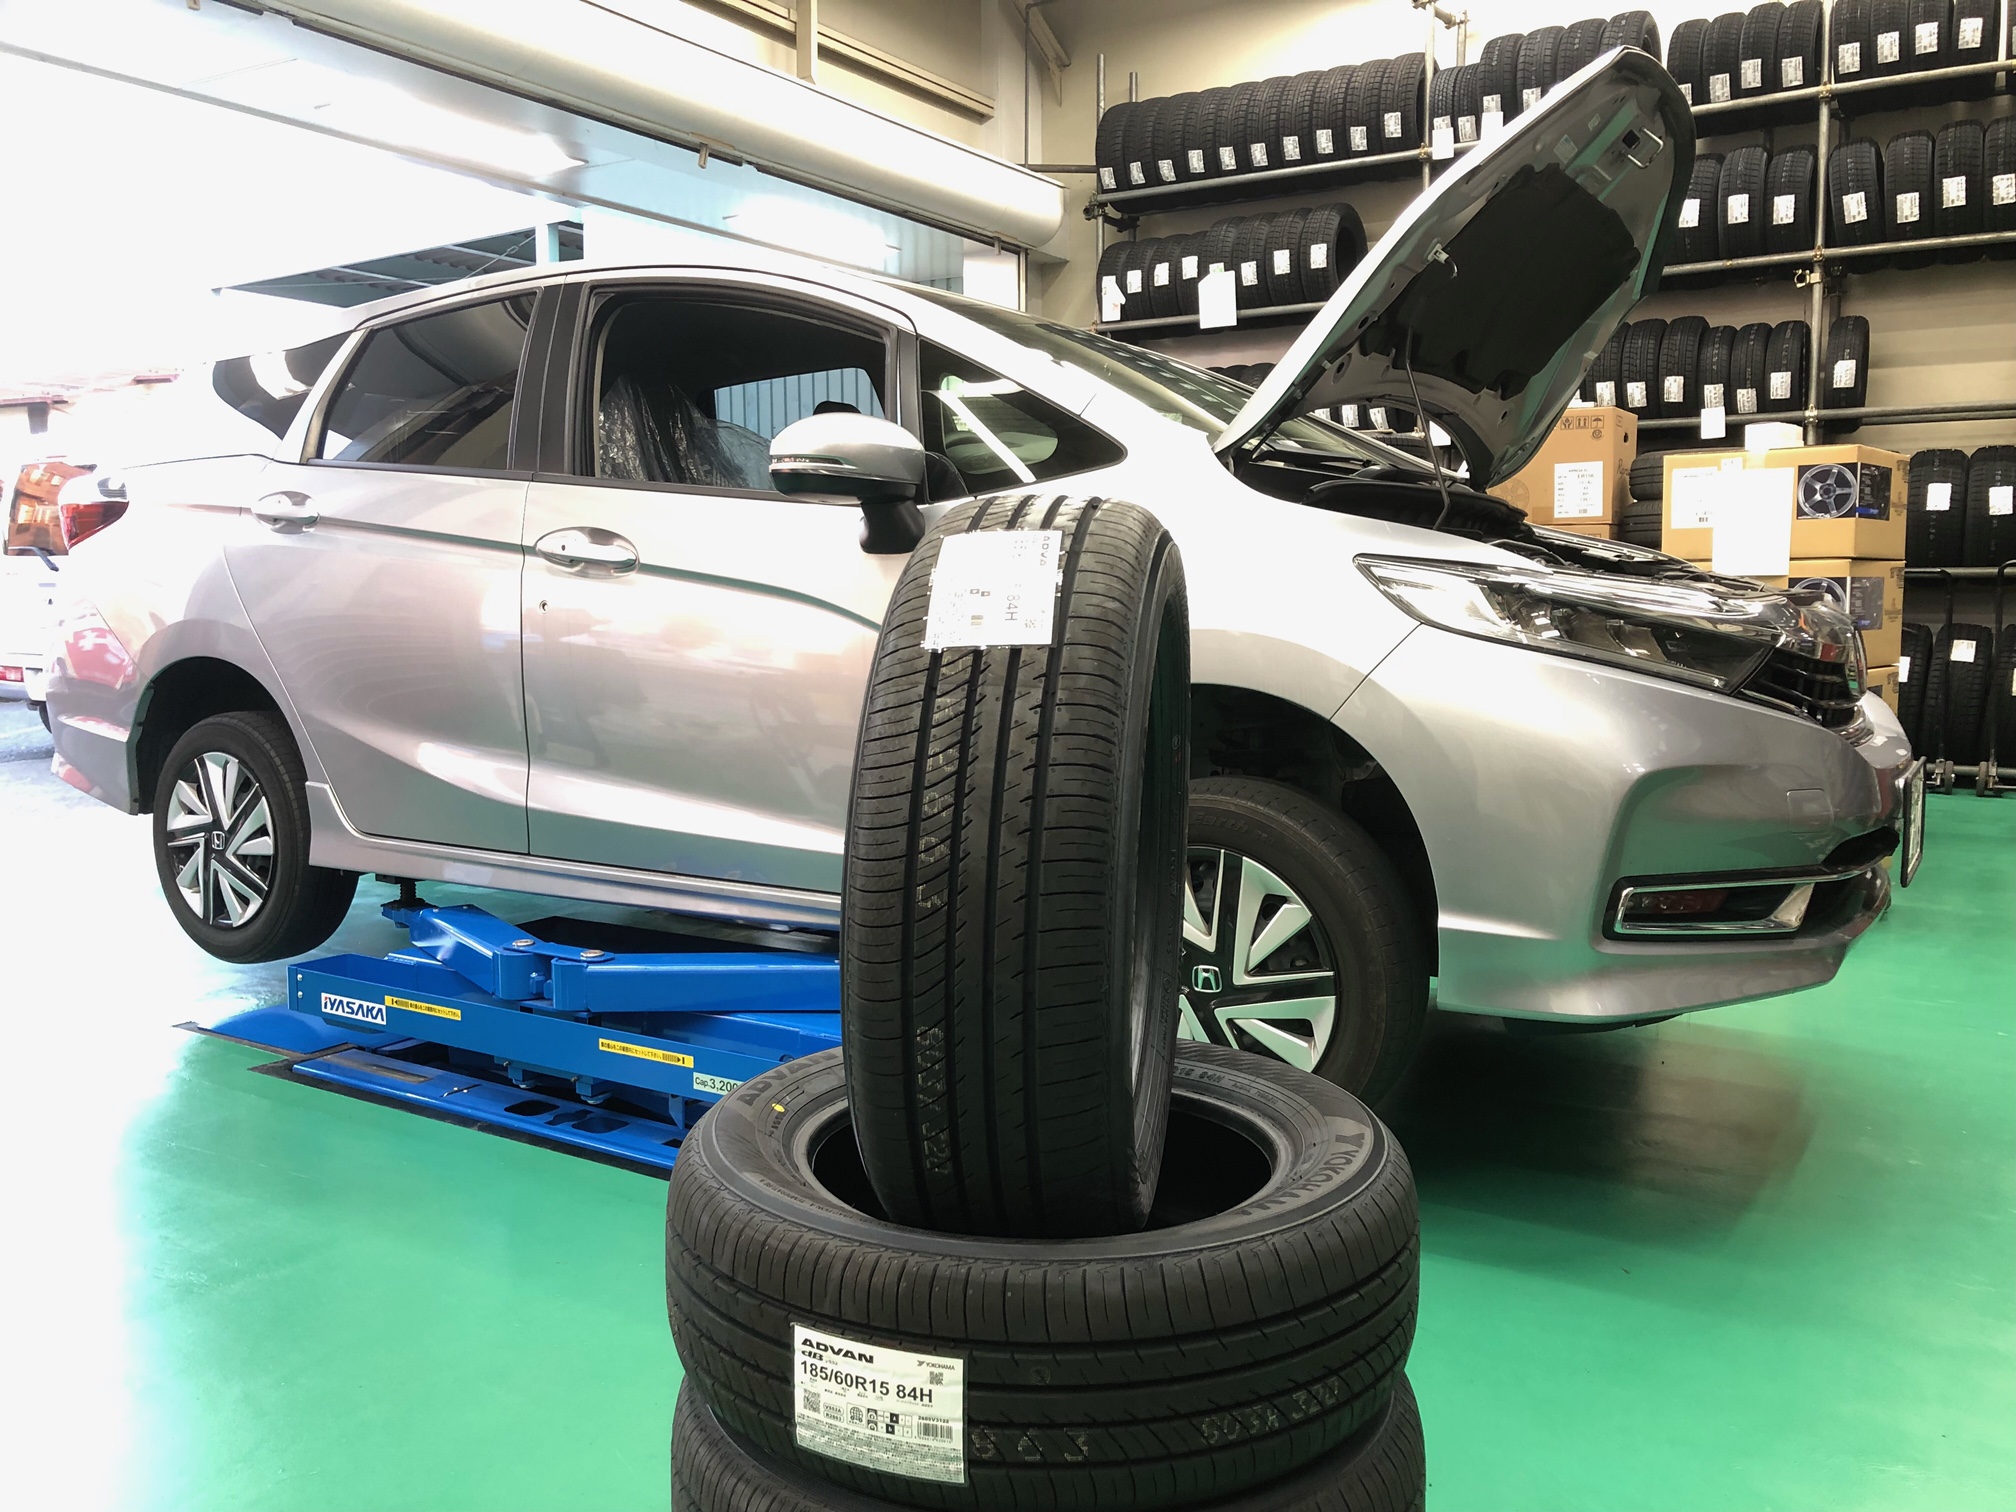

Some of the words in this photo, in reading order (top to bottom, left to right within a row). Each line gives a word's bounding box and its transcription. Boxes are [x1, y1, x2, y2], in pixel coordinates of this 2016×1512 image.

[801, 1338, 874, 1364] ADVAN
[801, 1350, 824, 1361] dB
[926, 1362, 955, 1371] YOKOHAMA
[801, 1360, 889, 1396] 185/60R15
[896, 1384, 932, 1403] 84H
